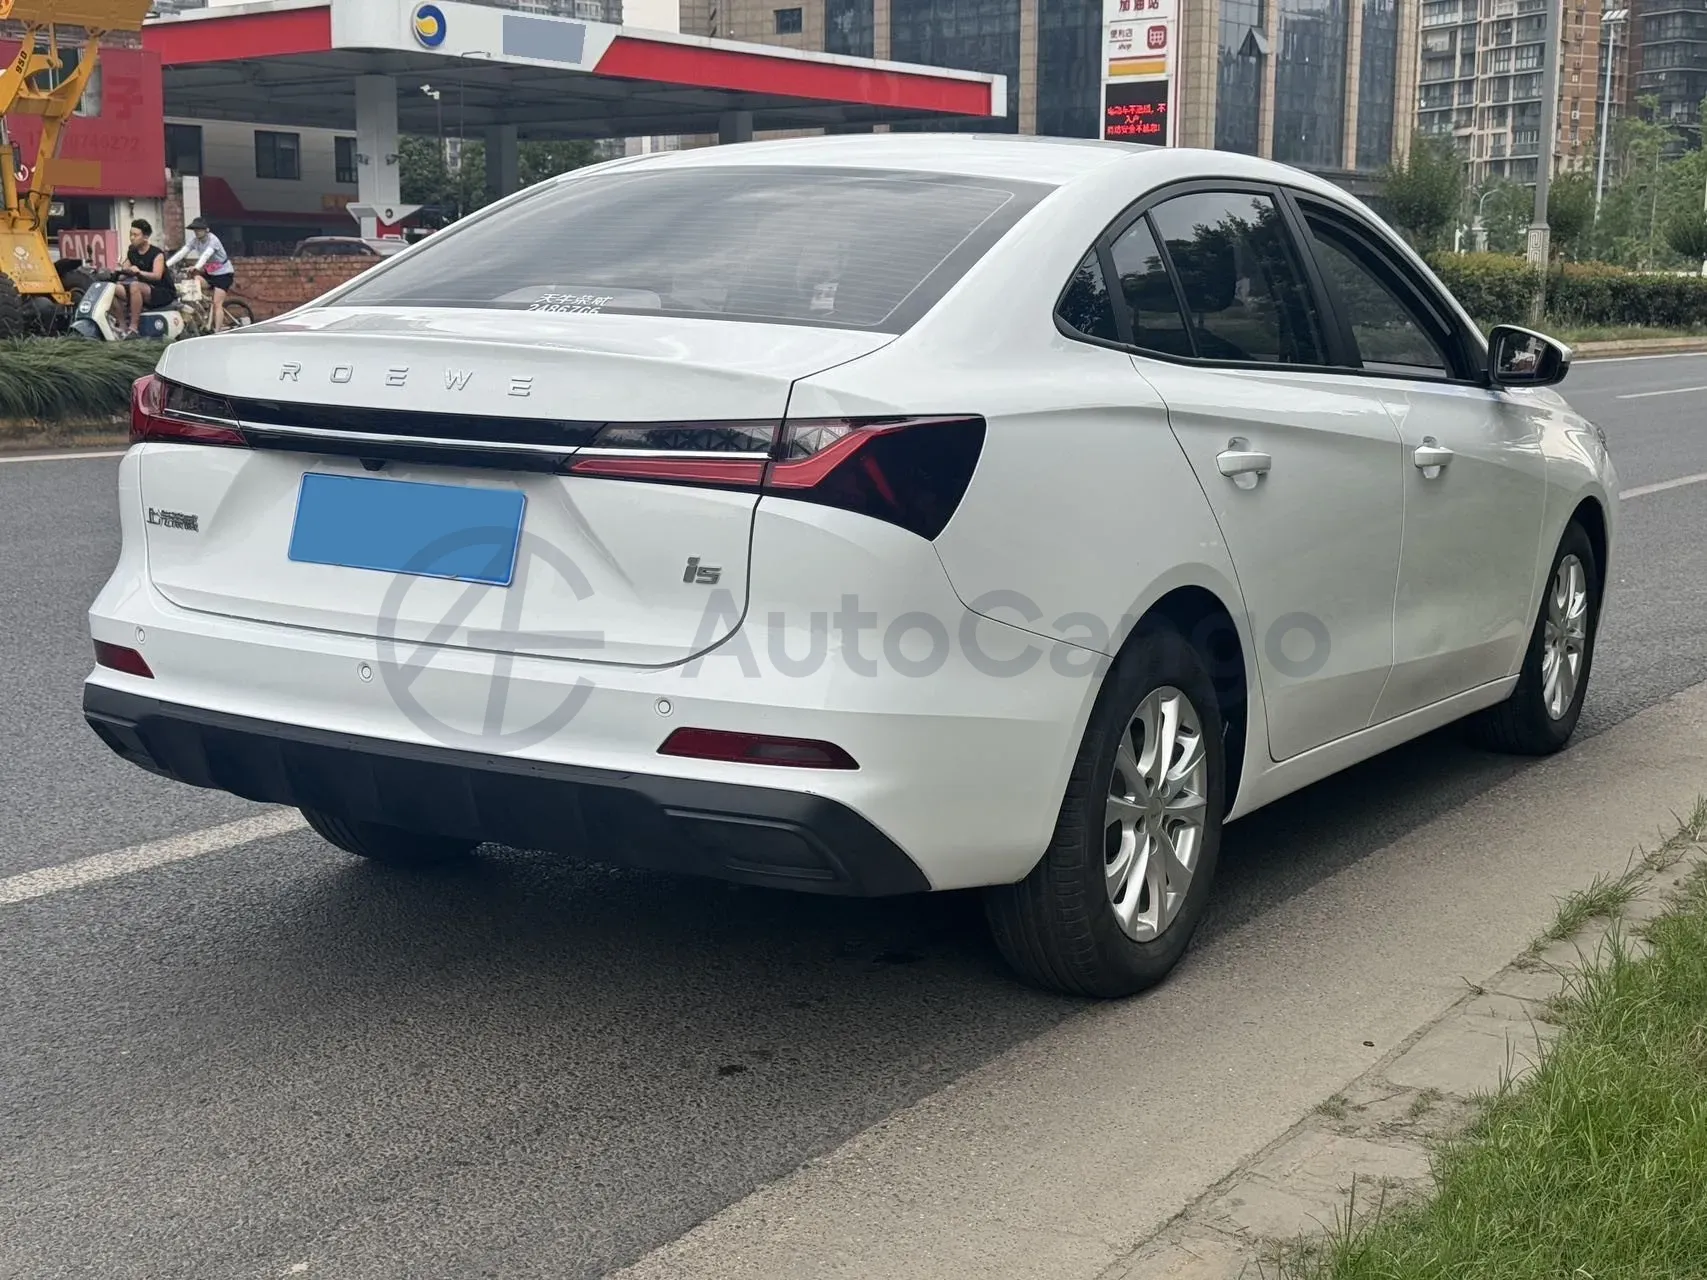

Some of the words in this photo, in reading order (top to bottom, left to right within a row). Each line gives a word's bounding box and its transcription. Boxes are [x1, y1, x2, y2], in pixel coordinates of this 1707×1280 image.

[1110, 28, 1133, 39] 便利店
[62, 234, 106, 269] CNG
[279, 361, 533, 397] ROEWE
